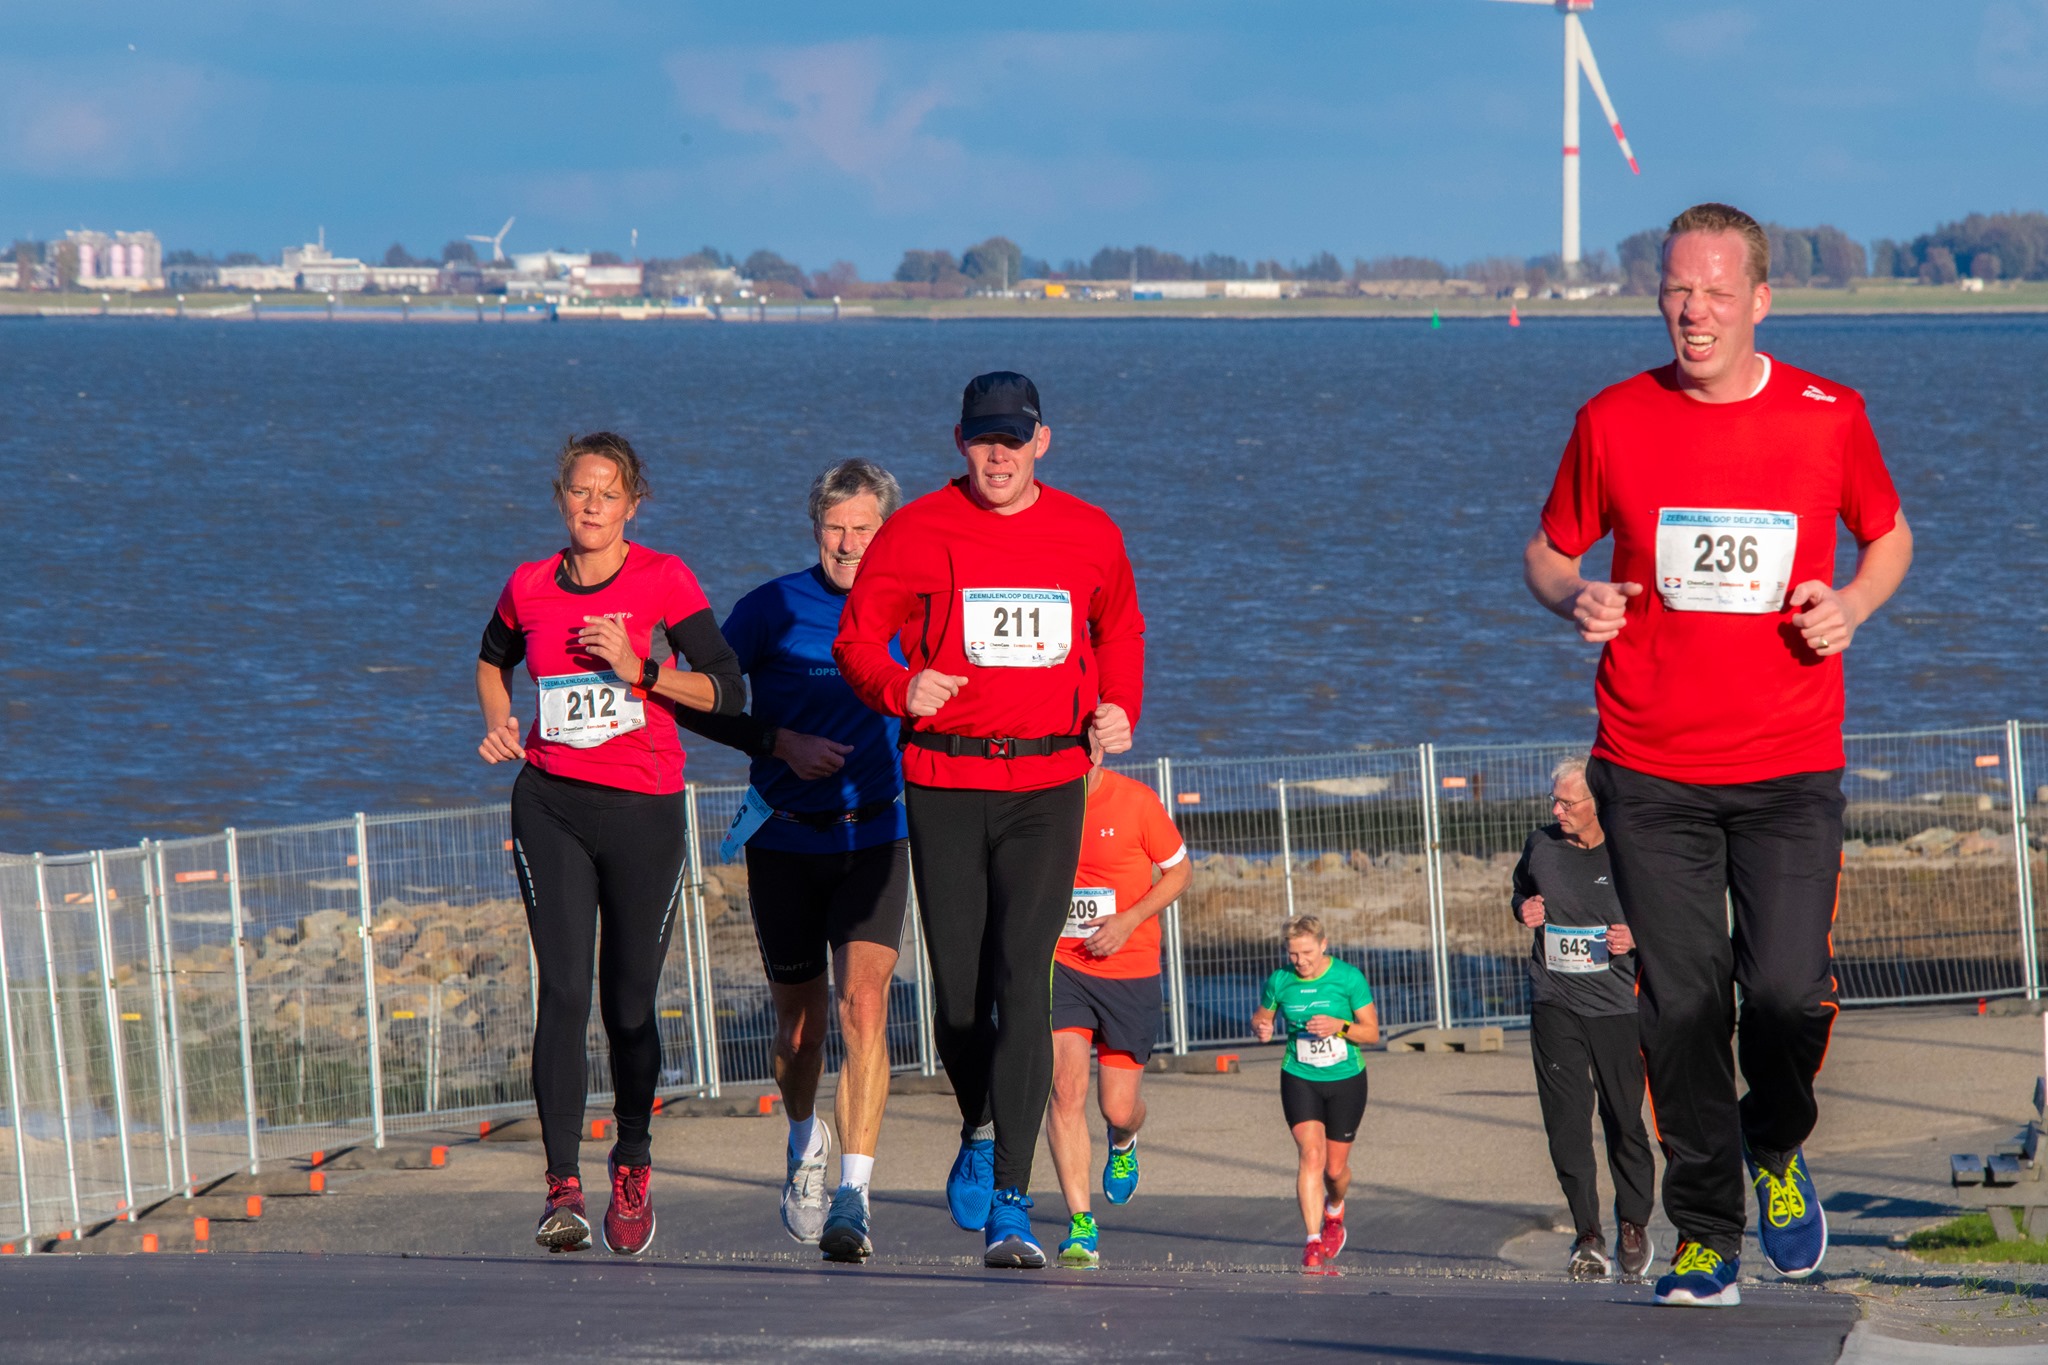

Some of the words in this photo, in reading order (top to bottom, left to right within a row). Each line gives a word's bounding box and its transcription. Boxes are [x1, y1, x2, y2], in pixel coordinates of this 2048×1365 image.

[1733, 516, 1771, 525] DELFZIJL
[1694, 533, 1759, 574] 236
[993, 607, 1040, 638] 211
[566, 687, 617, 722] 212
[1068, 899, 1098, 919] 209
[1559, 937, 1591, 956] 643
[1310, 1038, 1333, 1055] 521
